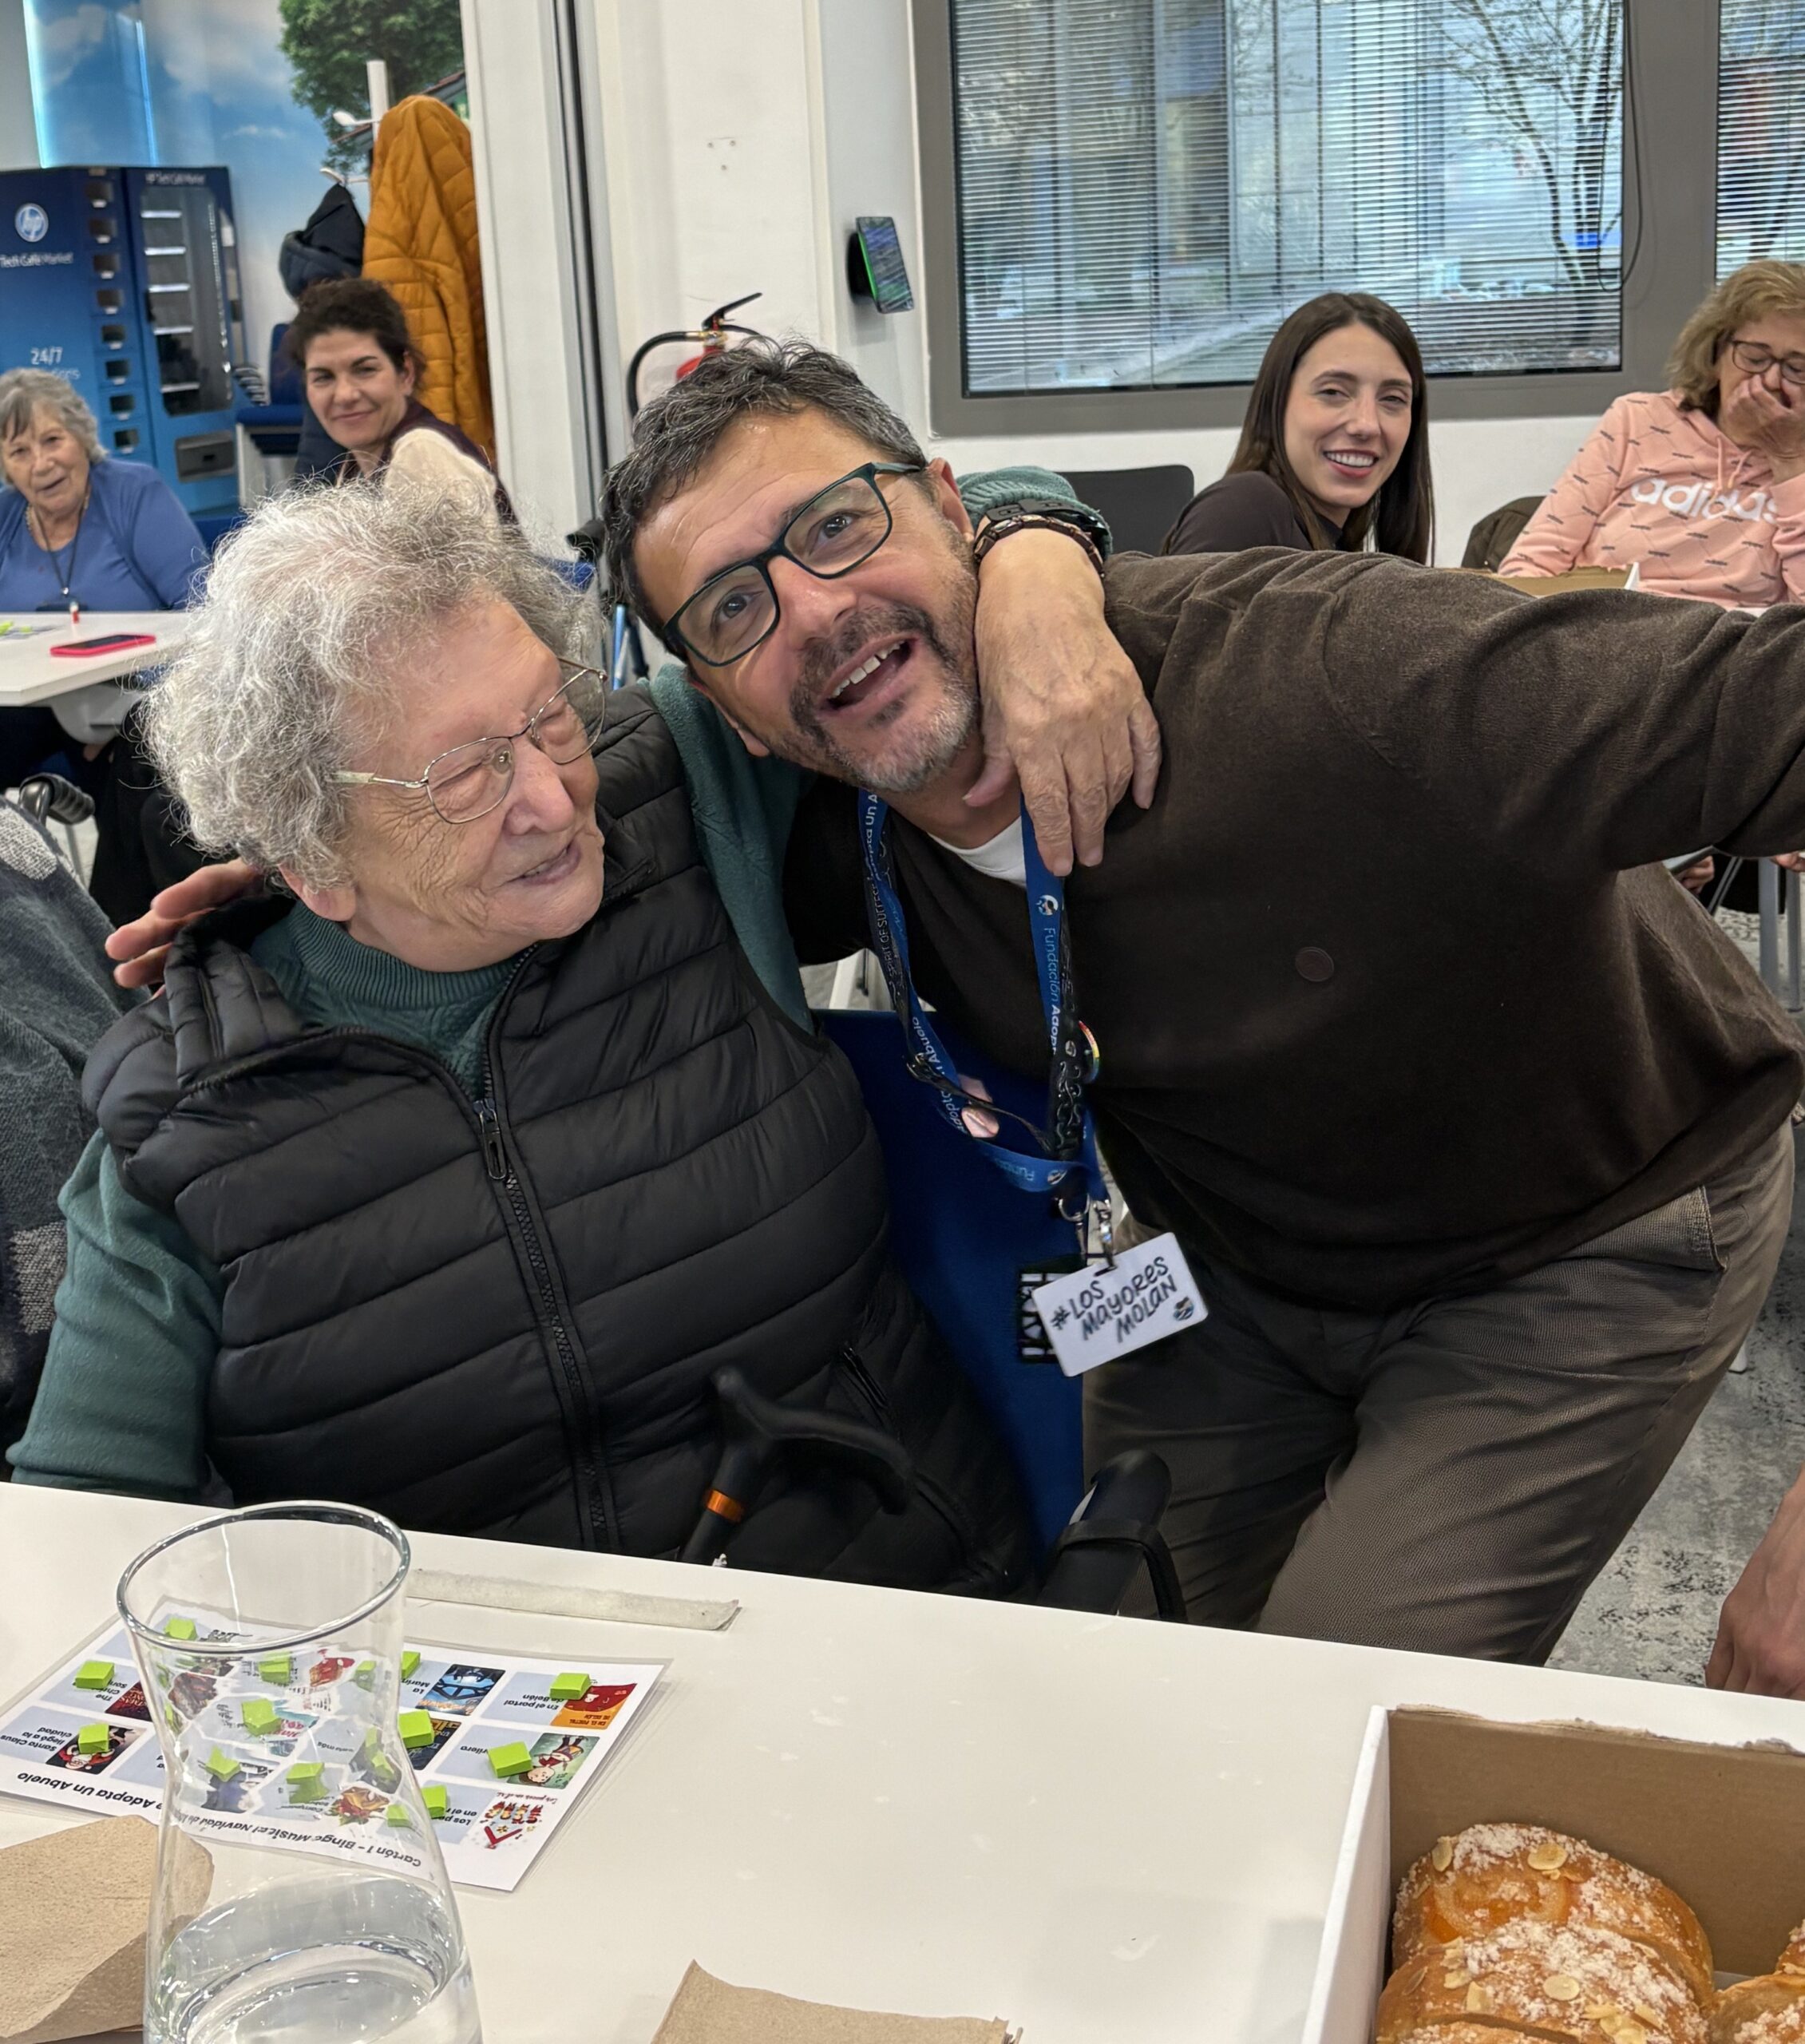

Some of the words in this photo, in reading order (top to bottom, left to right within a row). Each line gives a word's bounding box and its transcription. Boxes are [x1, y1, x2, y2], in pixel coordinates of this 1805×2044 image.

[31, 346, 63, 366] 24/7
[1630, 478, 1778, 524] adidas
[878, 929, 889, 943] OF
[912, 1016, 941, 1064] Abuelo
[503, 1699, 535, 1708] portal
[0, 1733, 28, 1745] Claus
[38, 1726, 73, 1738] ciudad
[29, 1738, 57, 1752] Santa
[18, 1773, 73, 1790] Abuelo
[73, 1784, 95, 1796] Un
[93, 1789, 156, 1808] Adopta
[376, 1846, 422, 1867] Cartón
